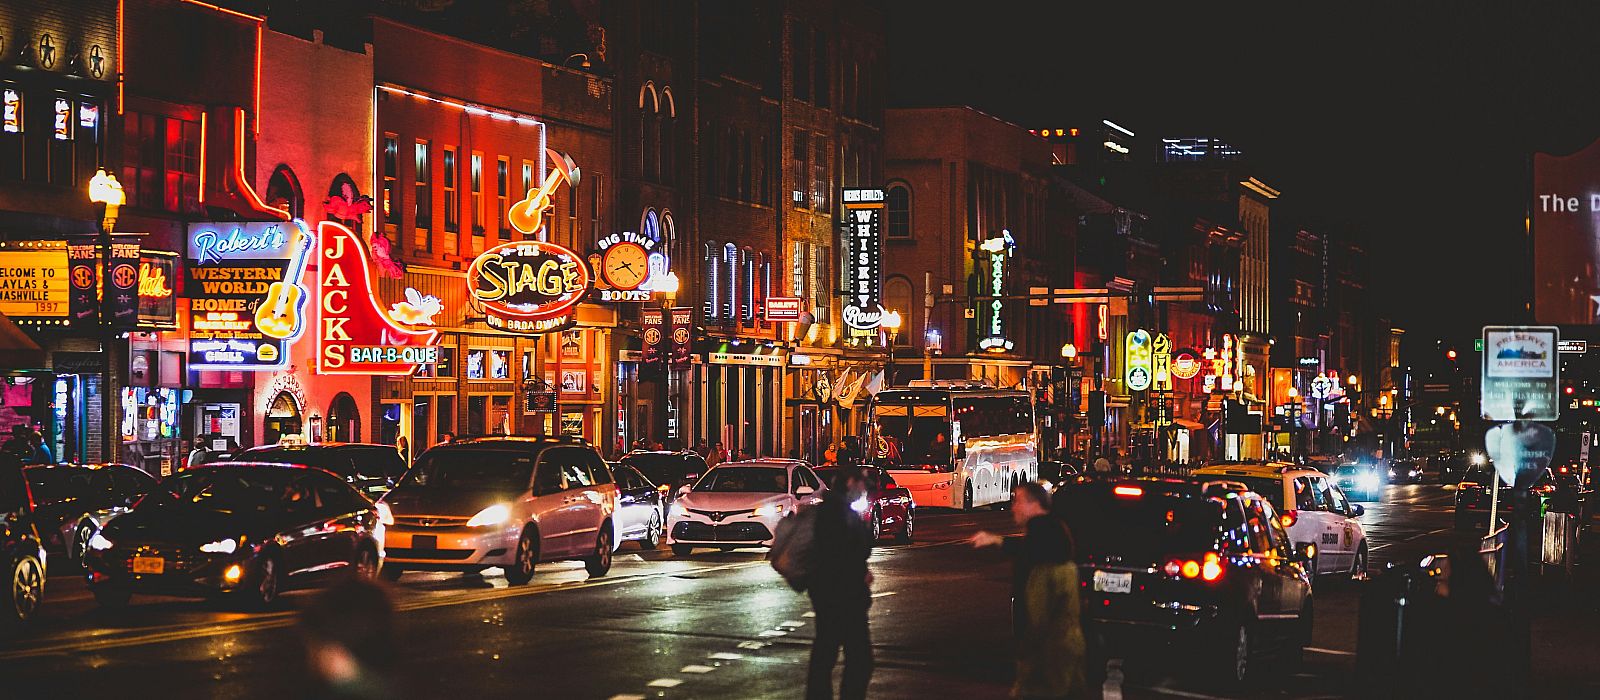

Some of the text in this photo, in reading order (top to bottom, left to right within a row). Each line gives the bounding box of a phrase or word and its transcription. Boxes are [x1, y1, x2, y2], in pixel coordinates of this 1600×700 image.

[1540, 194, 1579, 212] The
[194, 224, 287, 265] Robert's
[598, 231, 655, 250] BIG TIME
[69, 251, 95, 259] FANS
[111, 250, 140, 258] FANS
[855, 210, 872, 307] WHISKEY
[0, 268, 55, 278] ELCOME TO
[190, 267, 282, 280] WESTERN
[476, 253, 583, 300] STAGE
[42, 280, 49, 289] &
[202, 281, 269, 294] WORLD
[322, 235, 353, 368] JACKS
[601, 290, 650, 301] BOOTS
[36, 302, 58, 312] 1997
[191, 298, 260, 314] HOME of
[487, 314, 567, 330] ON BROADWAY
[845, 305, 881, 327] Row
[215, 331, 233, 339] Tonk
[234, 331, 263, 339] Heaven
[350, 346, 437, 363] BAR-B-QUE
[1496, 360, 1547, 368] AMERICA
